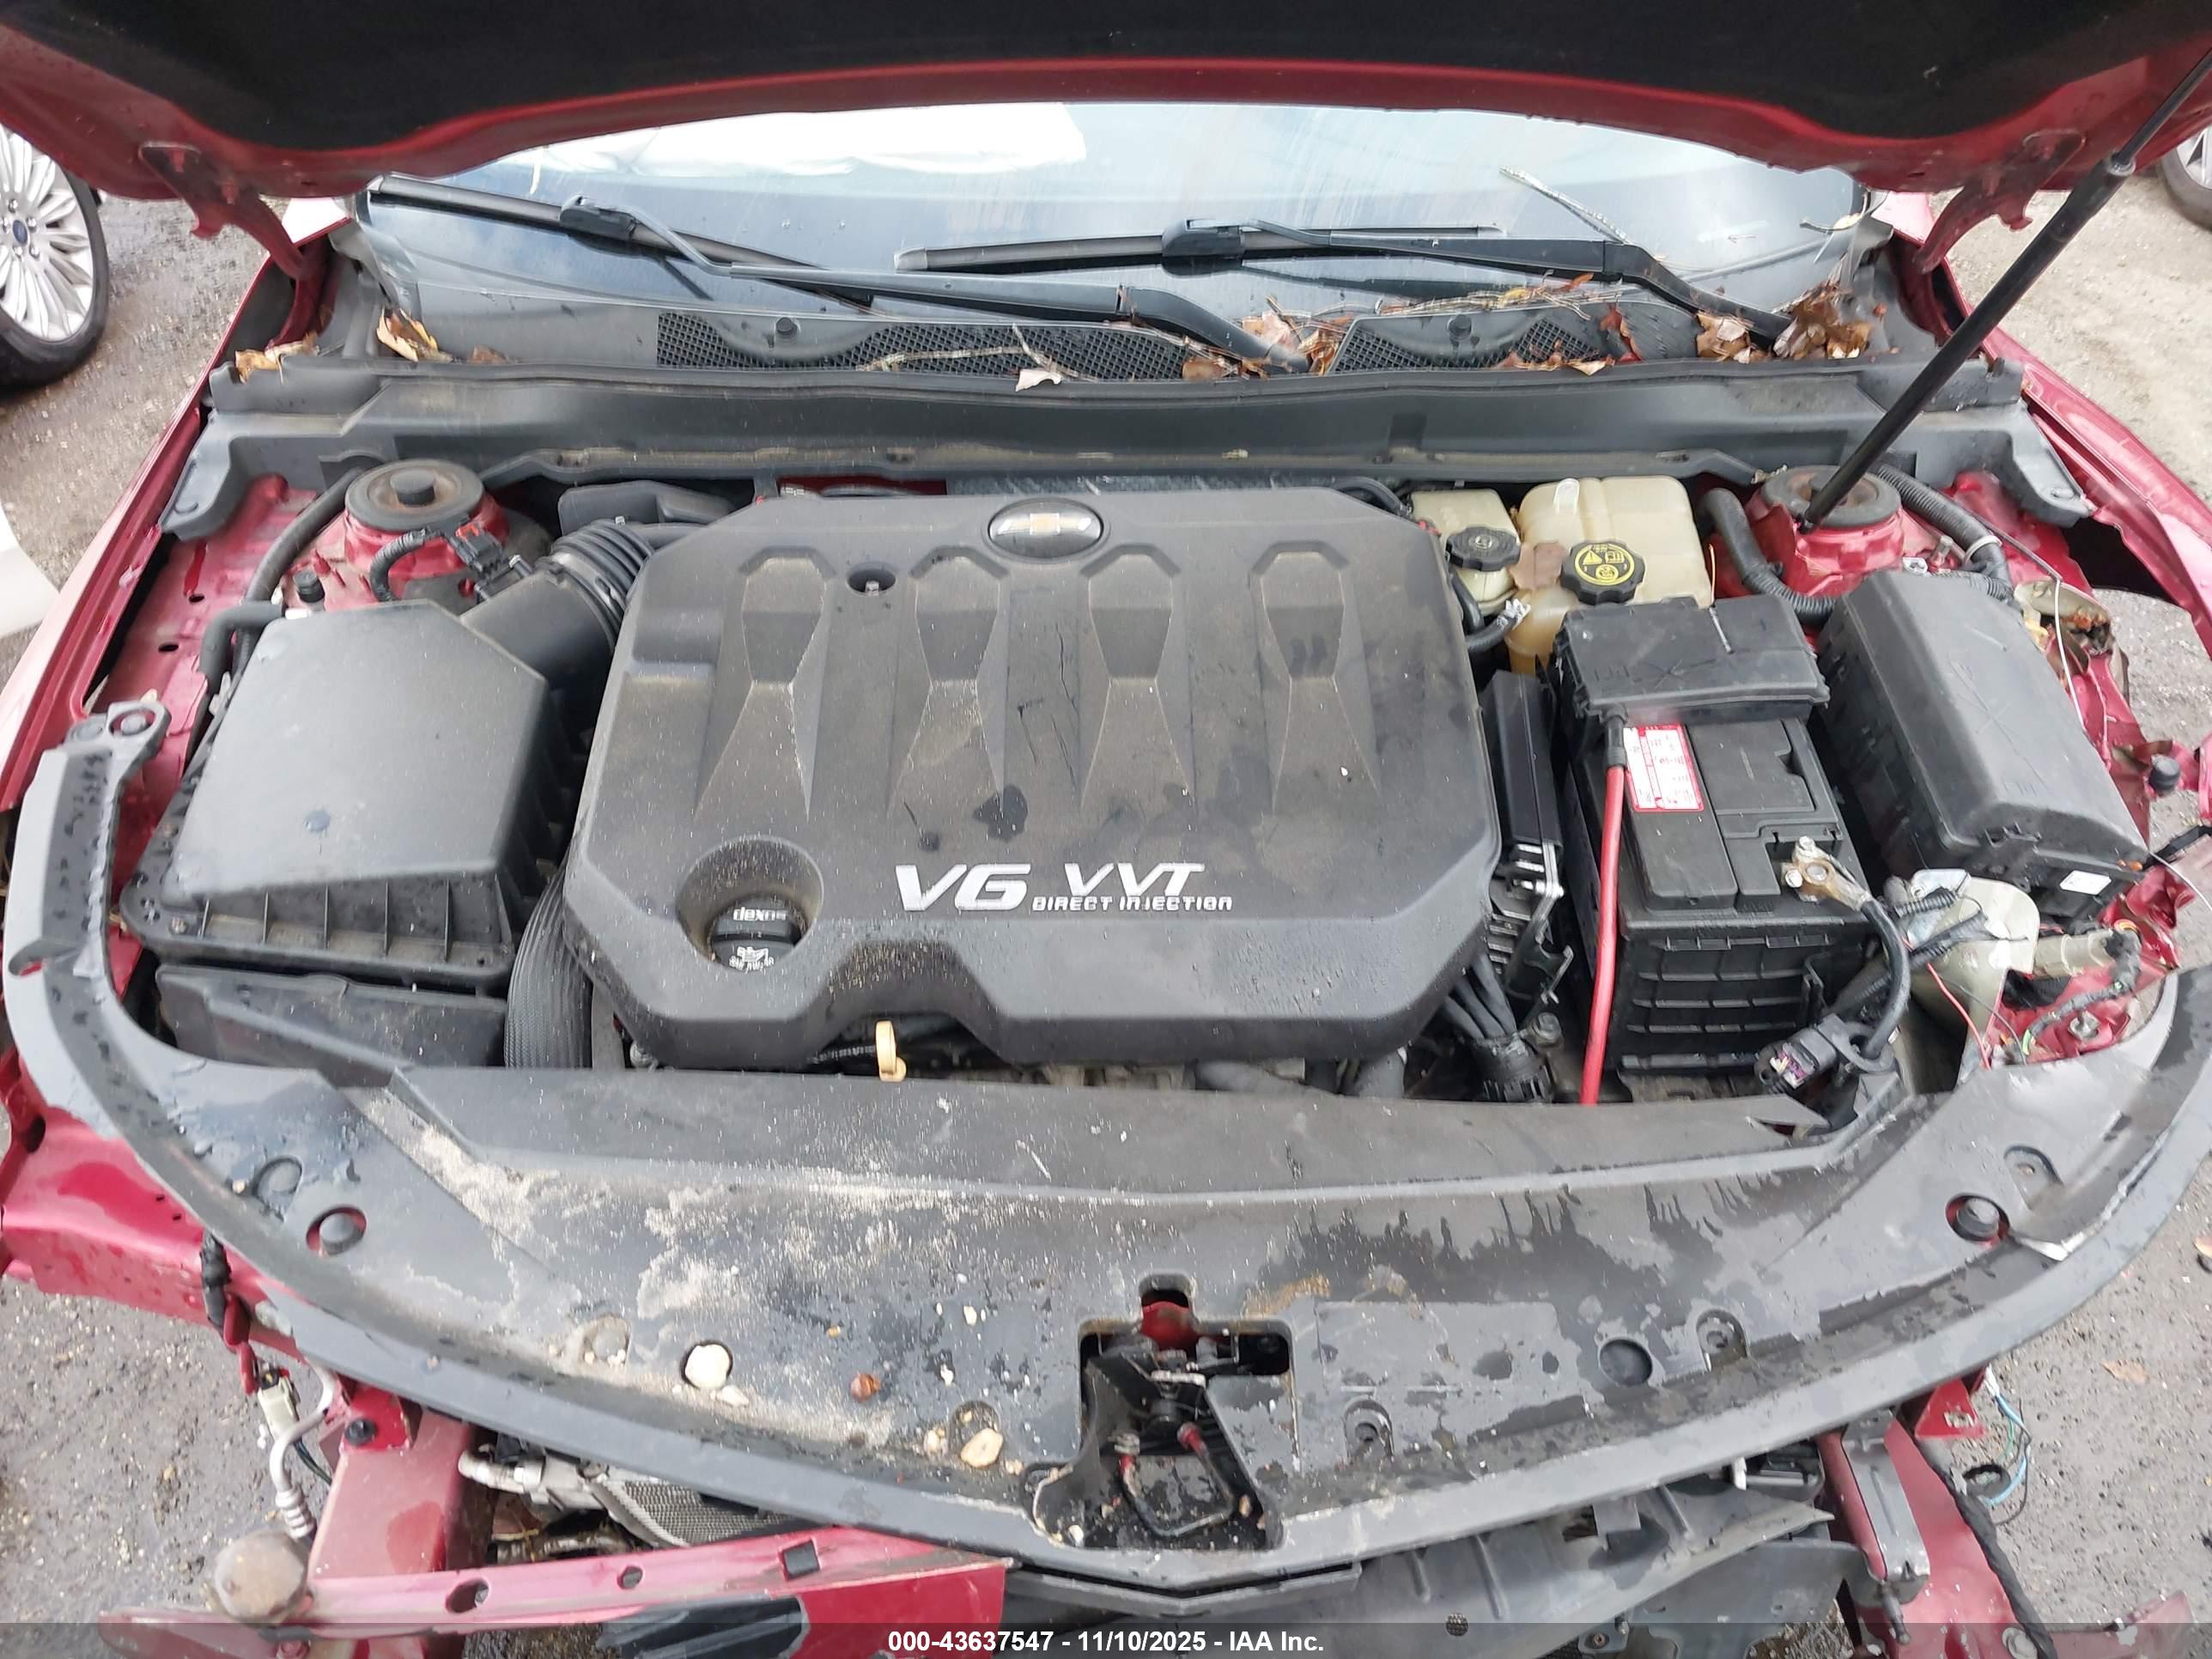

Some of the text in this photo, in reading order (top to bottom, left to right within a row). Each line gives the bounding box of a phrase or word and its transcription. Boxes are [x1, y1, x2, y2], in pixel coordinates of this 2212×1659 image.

[896, 862, 1206, 911] V6 VVT
[1032, 896, 1233, 911] DIRECT INJECTION
